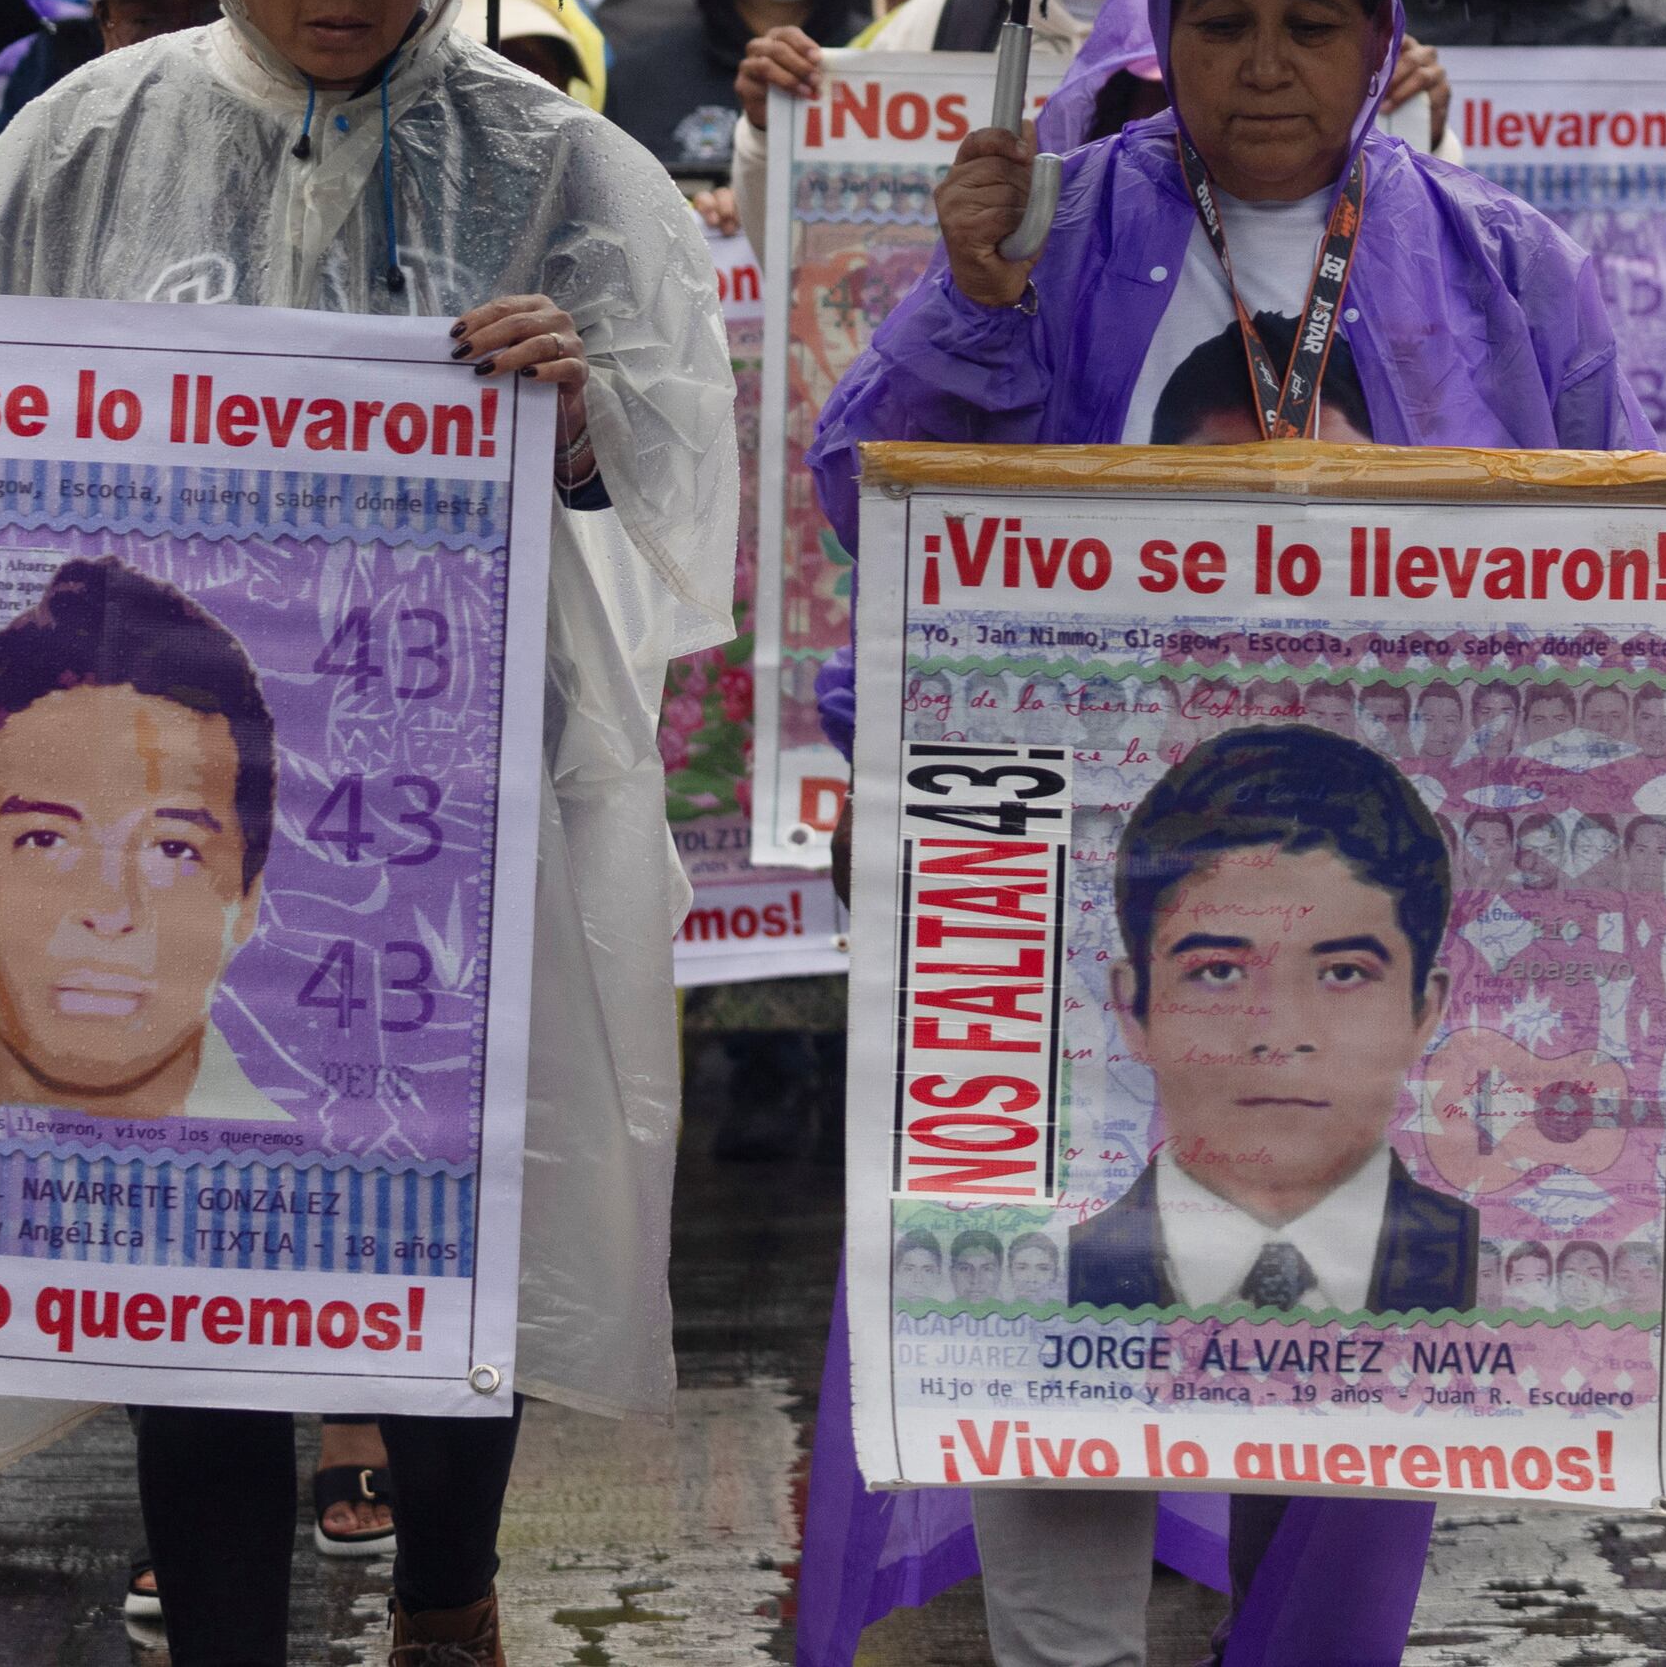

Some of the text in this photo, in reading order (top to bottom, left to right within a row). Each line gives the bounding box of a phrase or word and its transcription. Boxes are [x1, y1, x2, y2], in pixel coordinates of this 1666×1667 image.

[805, 80, 970, 147] ¡Nos
[1319, 252, 1347, 283] DC
[75, 369, 142, 441] lo
[170, 374, 499, 458] llevaron!
[59, 478, 163, 505] Escocia,
[180, 485, 260, 508] quiero
[275, 486, 341, 508] saber
[355, 489, 423, 514] dónde
[436, 493, 489, 517] está
[922, 516, 1112, 605] ¡Vivo
[1138, 539, 1227, 595] se
[1255, 524, 1322, 596] lo
[313, 606, 453, 700] 43
[921, 623, 959, 647] Yo,
[977, 624, 1017, 646] Jan
[1031, 625, 1110, 651] Nimmo,
[1124, 628, 1232, 655] Glasgow,
[1248, 629, 1354, 658] Escocia,
[1368, 633, 1450, 663] quiero
[1464, 635, 1529, 659] saber
[1542, 634, 1609, 660] dónde
[305, 772, 444, 866] 43
[297, 939, 437, 1034] 43
[905, 743, 1066, 1197] NOS FALTAN 43!
[16, 1117, 102, 1140] llevaron,
[114, 1123, 167, 1141] vivos
[179, 1126, 210, 1144] los
[220, 1130, 305, 1148] queremos
[22, 1177, 179, 1210] NAVARRETE
[197, 1185, 342, 1216] GONZÁLEZ
[17, 1218, 145, 1250] Angélica
[196, 1229, 296, 1255] TIXTLA
[343, 1235, 377, 1257] 18
[393, 1236, 459, 1261] años
[35, 1286, 427, 1353] queremos!
[899, 1343, 928, 1366] DE
[1042, 1328, 1517, 1375] JORGE ÁLVAREZ NAVA
[920, 1377, 1634, 1408] Hijo de Epifanio y Blanca 19 años Juan R. Escudero
[939, 1418, 1121, 1483] ¡Vivo
[1144, 1423, 1210, 1479] lo
